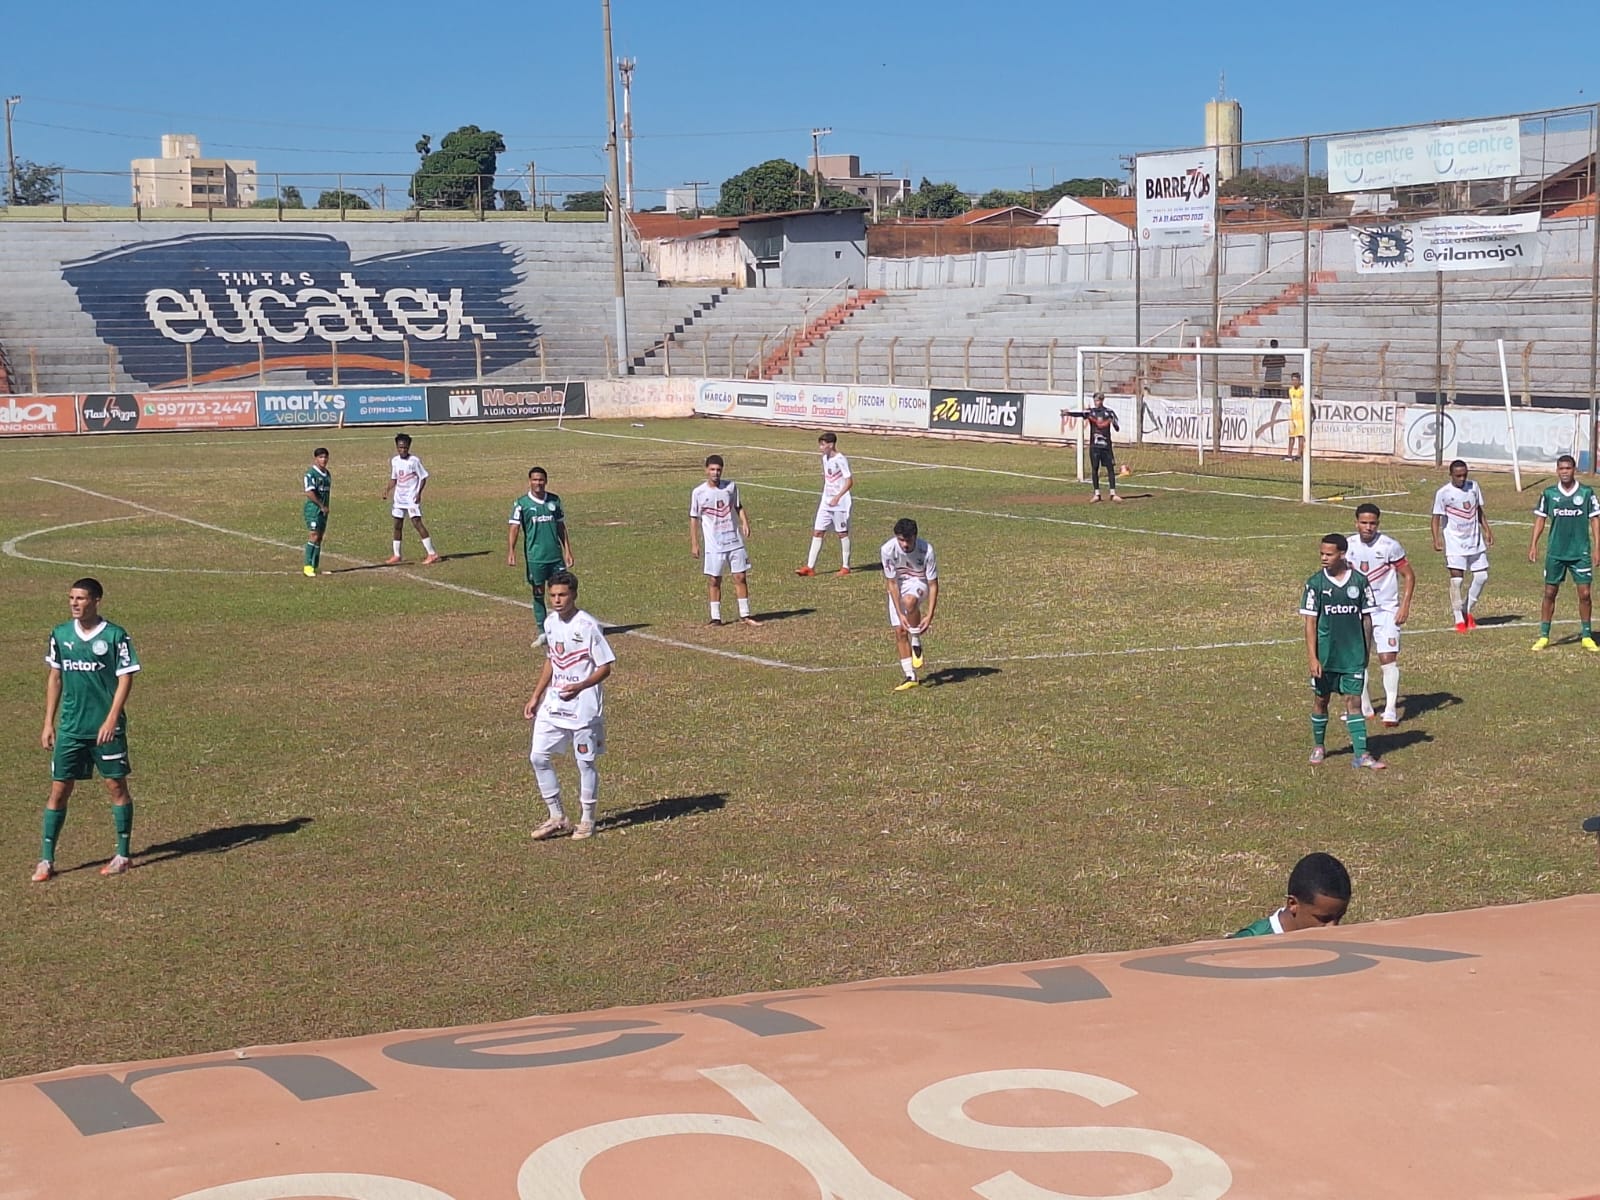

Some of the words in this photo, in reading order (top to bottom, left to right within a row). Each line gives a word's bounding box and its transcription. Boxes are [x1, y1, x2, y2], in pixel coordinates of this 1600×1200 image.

[1426, 137, 1454, 158] vita
[1458, 133, 1513, 154] centre
[1335, 149, 1363, 168] vita
[1366, 144, 1414, 164] centre
[1423, 243, 1524, 262] @vilamajo1
[218, 271, 314, 286] TINTAS
[145, 272, 497, 343] eucatex
[265, 391, 345, 411] mark's
[482, 387, 565, 406] Morada
[157, 401, 252, 416] 99773-2447
[961, 396, 1018, 427] williarts
[62, 659, 98, 672] Fictor
